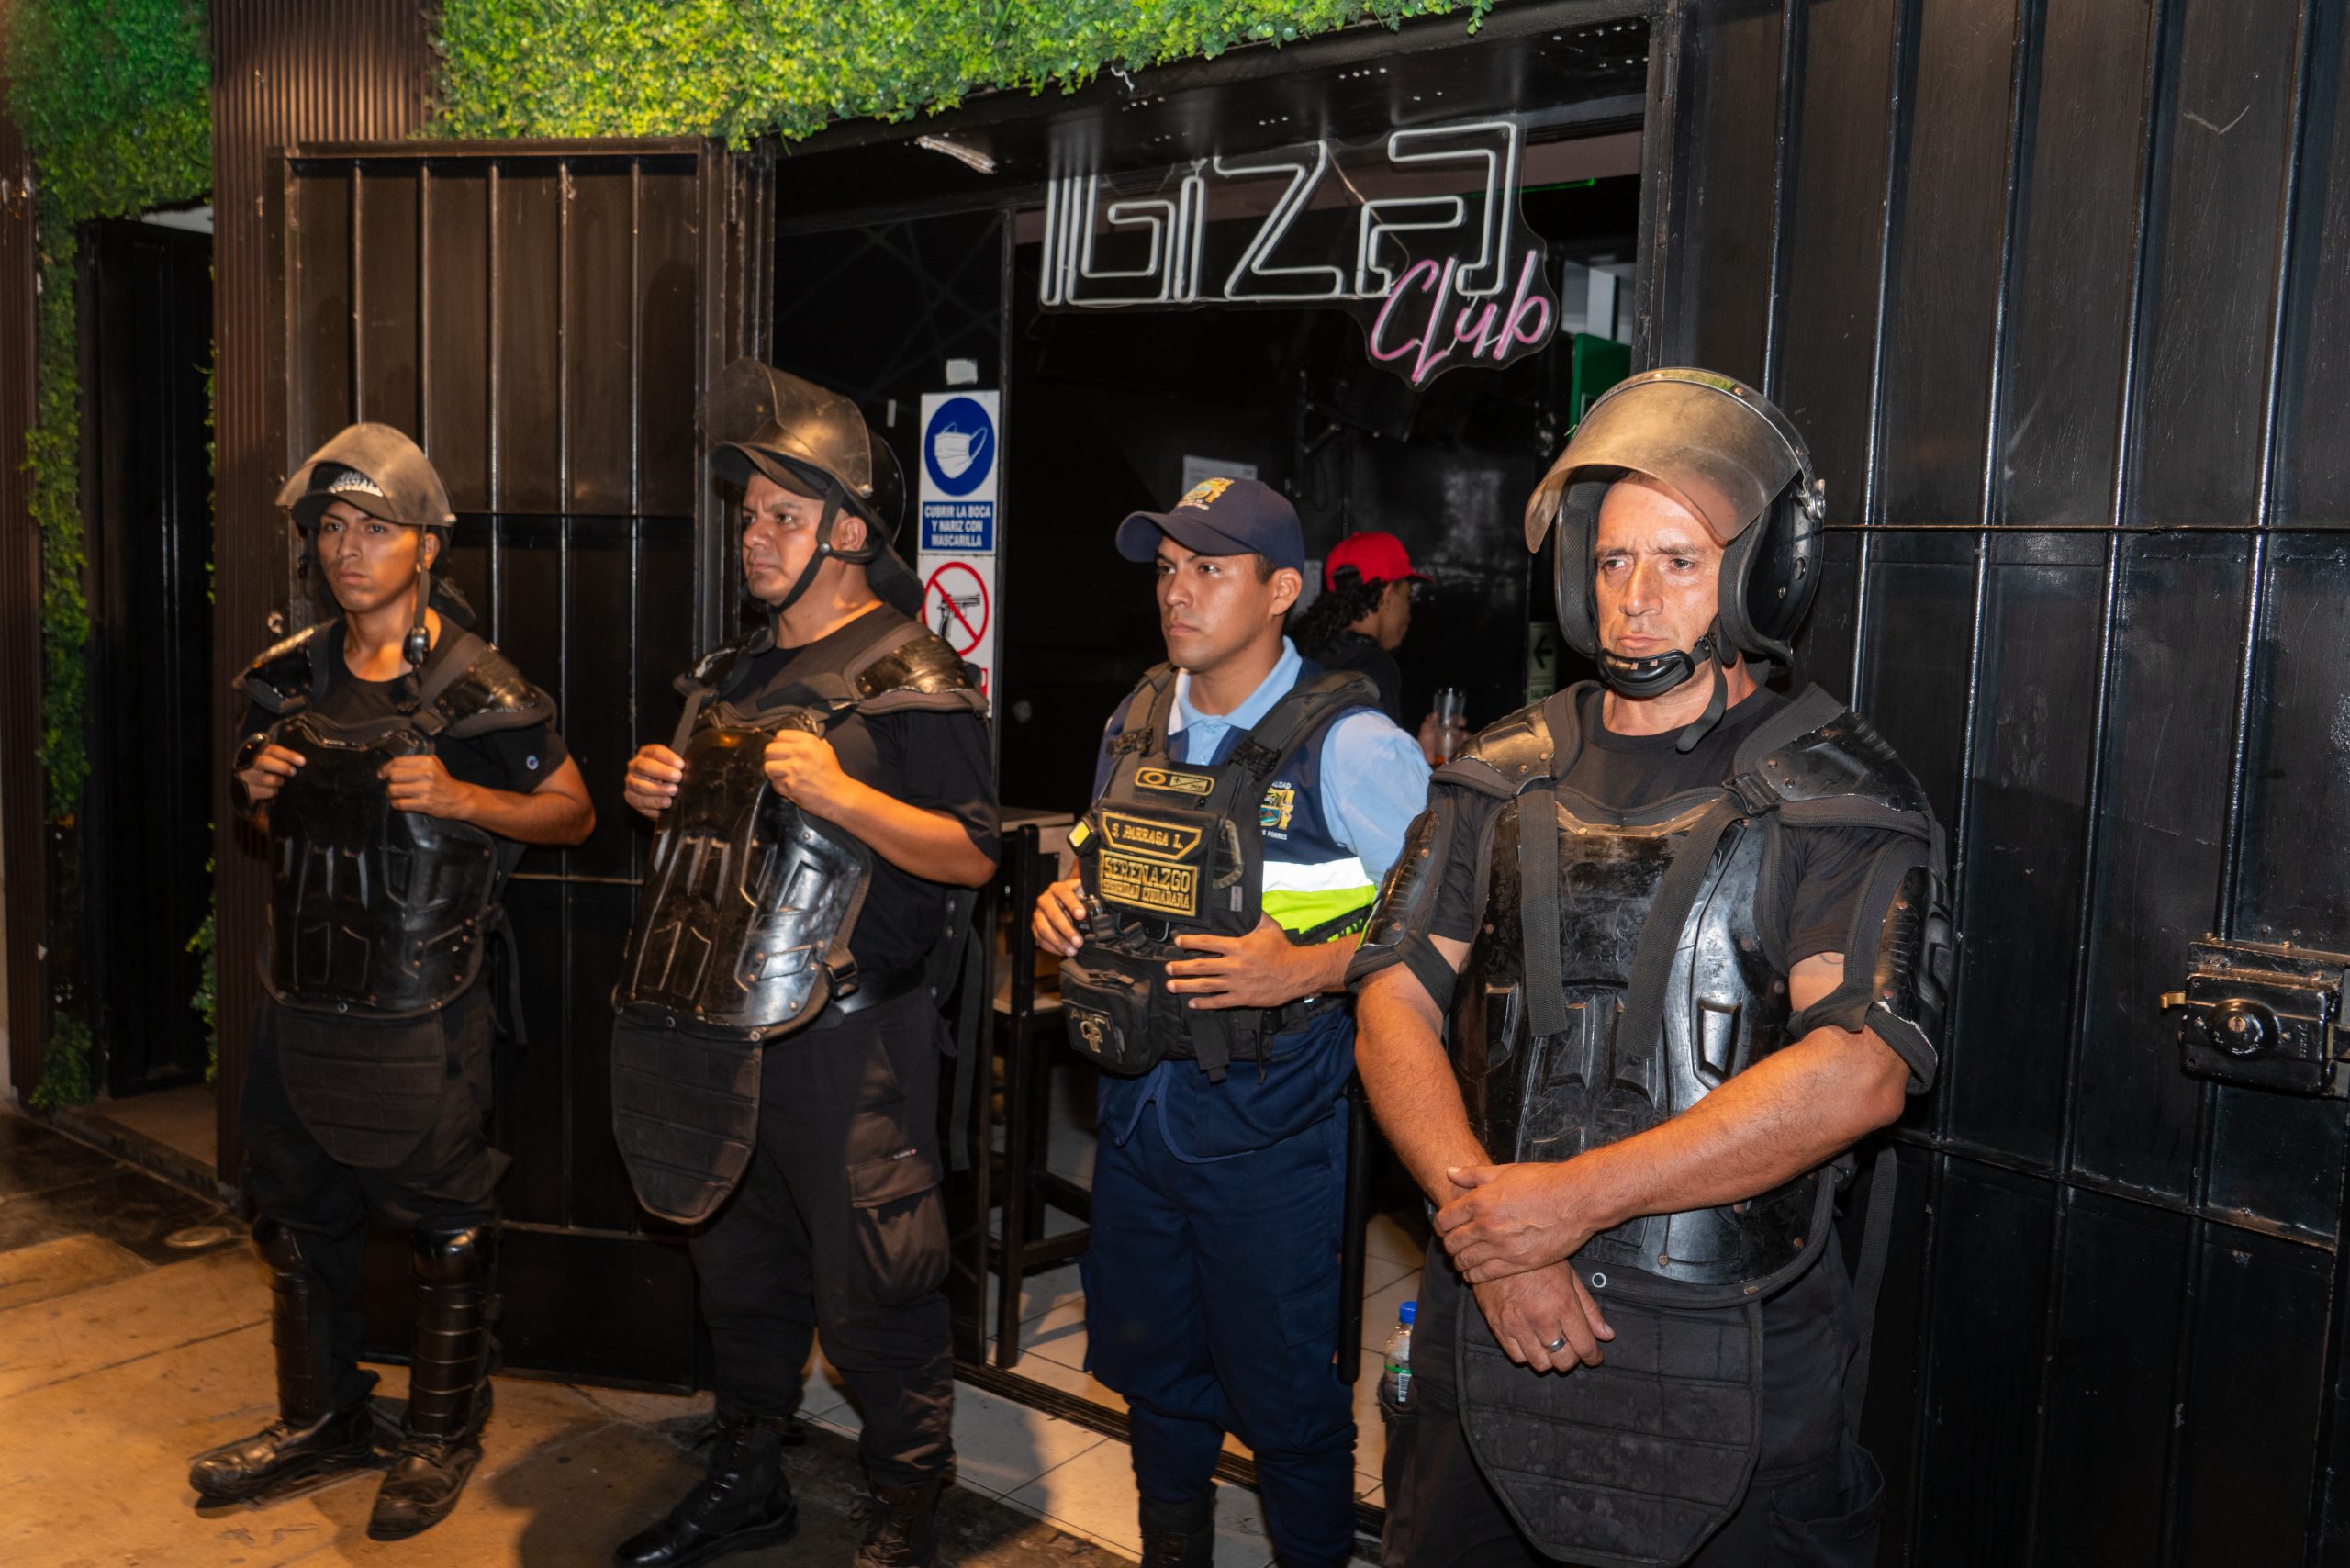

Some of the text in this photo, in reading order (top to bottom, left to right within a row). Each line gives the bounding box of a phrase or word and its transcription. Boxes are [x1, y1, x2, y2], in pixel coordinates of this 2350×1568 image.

[1370, 249, 1550, 386] Club
[924, 505, 990, 518] CUBRIR LA BOCA
[931, 520, 983, 532] Y NARIZ CON
[931, 534, 982, 547] MASCARILLA
[1122, 824, 1169, 846] PARRAGA
[1103, 857, 1191, 893] SERENAZGO
